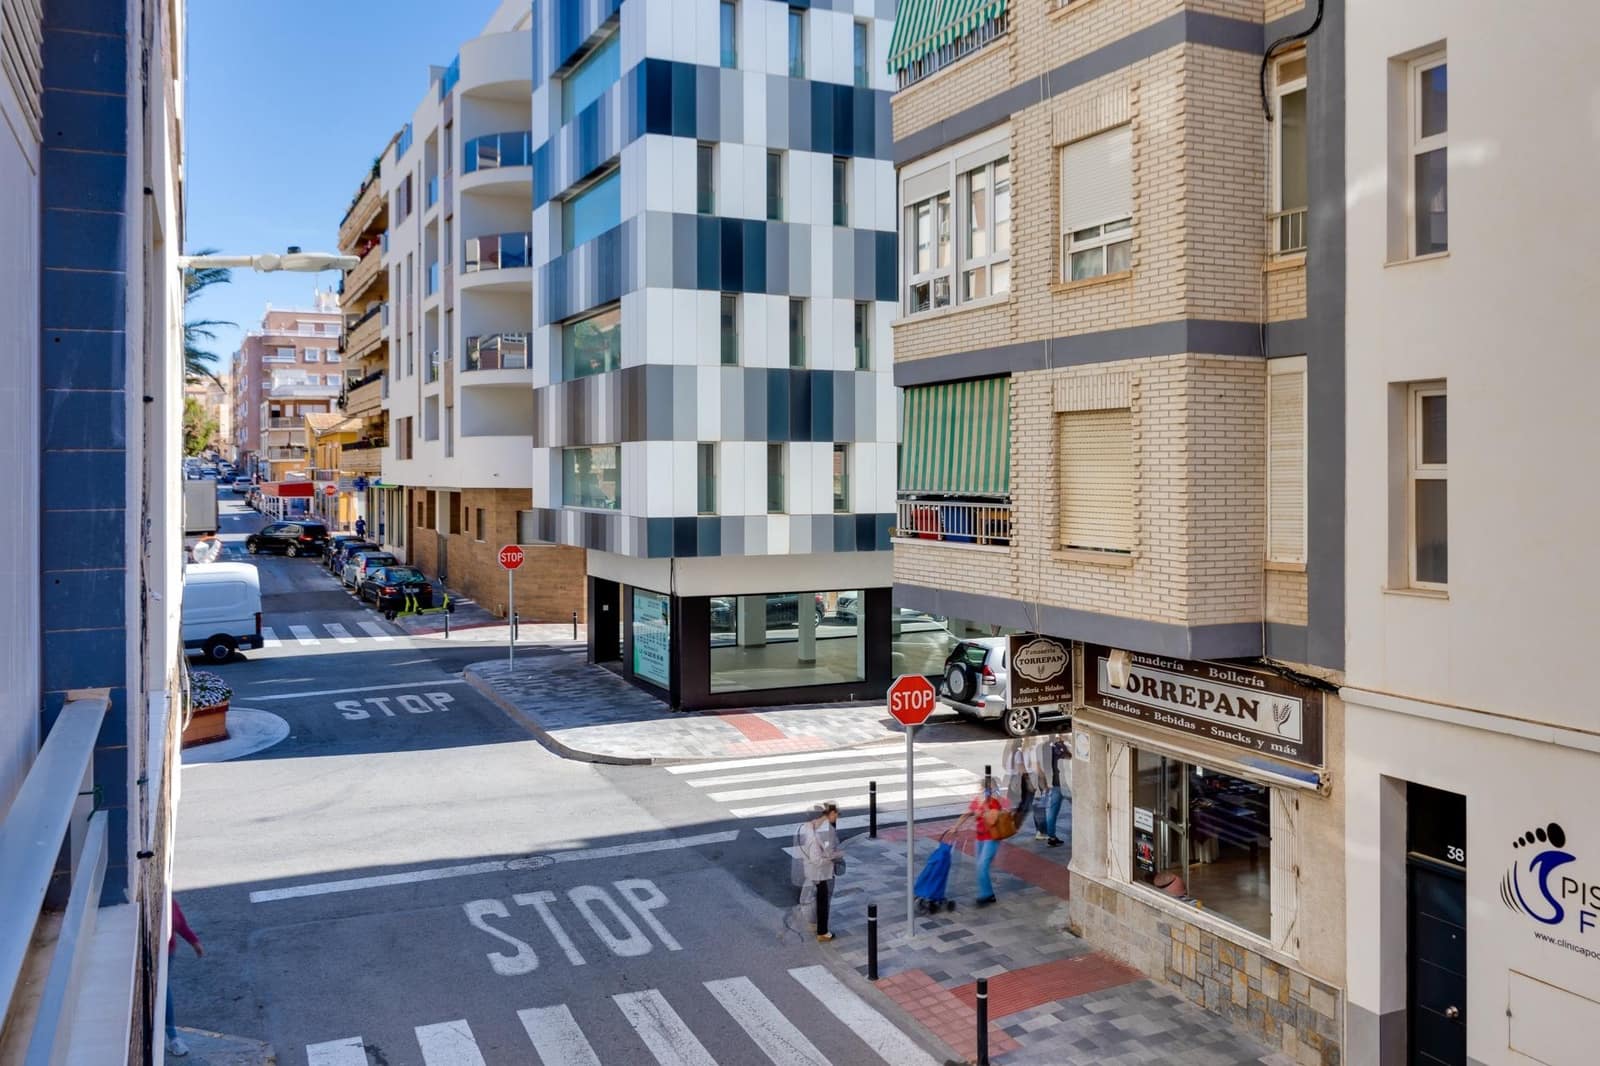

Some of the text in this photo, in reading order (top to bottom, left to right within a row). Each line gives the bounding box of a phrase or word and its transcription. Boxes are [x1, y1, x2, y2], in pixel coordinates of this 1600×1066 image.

[501, 552, 523, 562] STOP
[1019, 655, 1063, 665] TORREPAN
[1131, 654, 1184, 671] anadería
[1209, 667, 1265, 687] Bollería
[334, 692, 455, 720] STOP
[892, 690, 932, 711] STOP
[1111, 673, 1260, 722] ORREPAN
[1102, 698, 1141, 715] Helados
[1154, 711, 1196, 730] Bebidas
[1210, 725, 1251, 745] Snacks
[1256, 739, 1264, 749] y
[1270, 743, 1297, 756] más
[1447, 845, 1465, 862] 38
[462, 878, 683, 976] STOP
